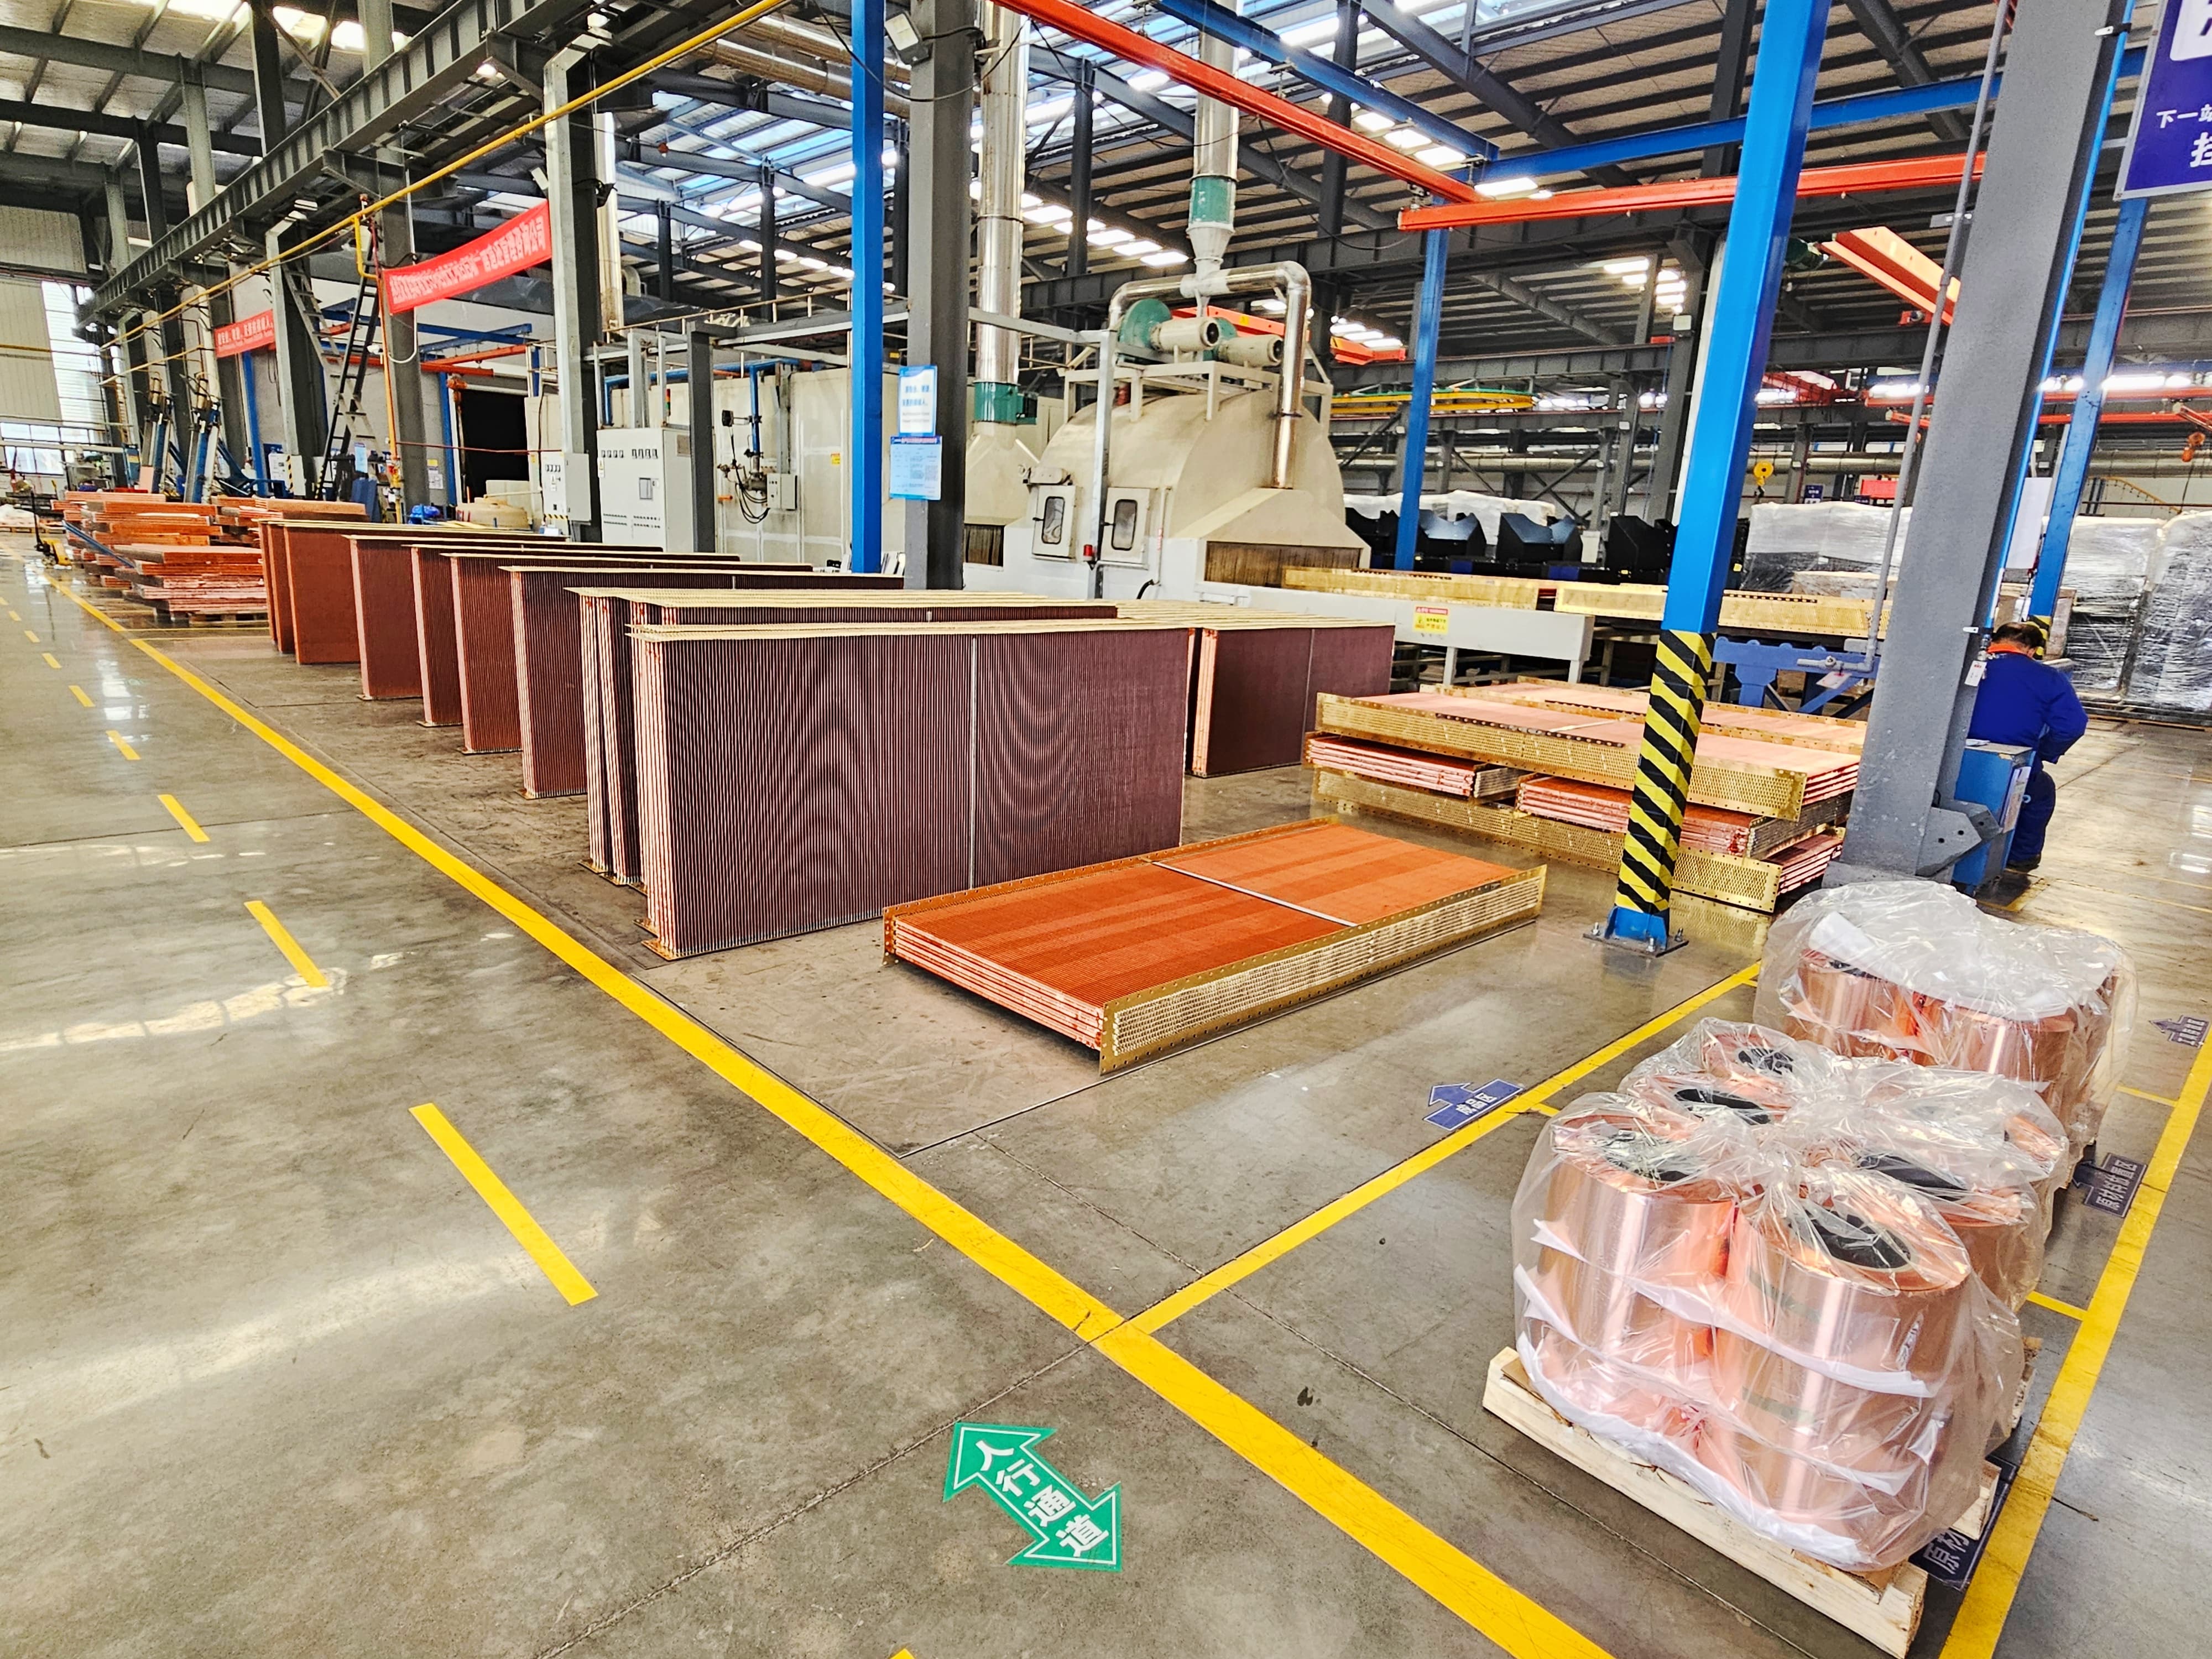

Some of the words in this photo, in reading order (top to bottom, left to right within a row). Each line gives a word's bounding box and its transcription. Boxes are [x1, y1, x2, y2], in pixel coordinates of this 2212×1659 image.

[1455, 1092, 1498, 1115] 成品区
[2096, 1159, 2137, 1211] 原材料放置区
[975, 1440, 1109, 1558] 人行通道
